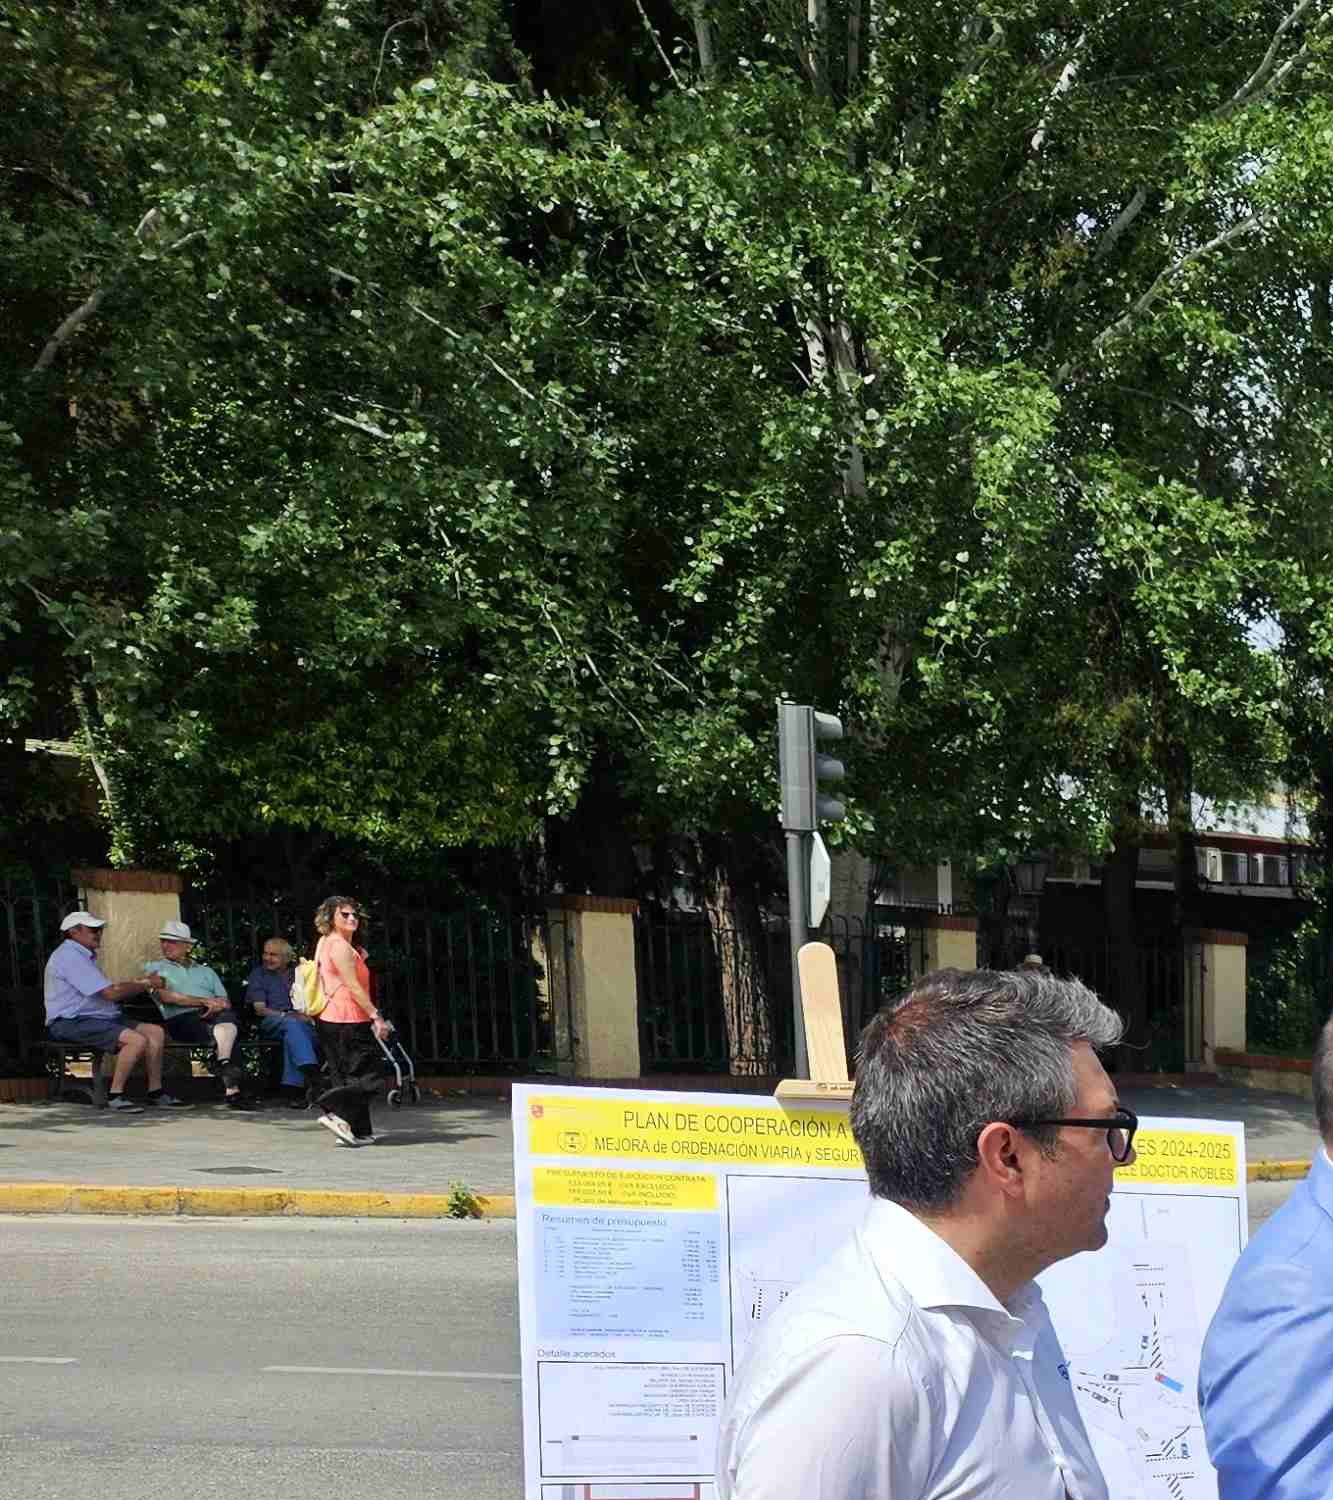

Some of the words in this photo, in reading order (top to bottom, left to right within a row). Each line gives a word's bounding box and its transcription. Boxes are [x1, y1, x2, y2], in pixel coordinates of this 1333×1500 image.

[624, 1110, 669, 1129] PLAN
[675, 1113, 698, 1131] DE
[704, 1114, 831, 1138] COOPERACIÓN
[838, 1122, 847, 1138] A
[594, 1137, 650, 1152] MEJORA
[653, 1140, 668, 1154] de
[671, 1139, 757, 1158] ORDENACIÓN
[758, 1144, 801, 1159] VIARIA
[805, 1151, 811, 1163] y
[815, 1147, 862, 1162] SEGUR
[1136, 1138, 1156, 1156] ES
[1160, 1140, 1231, 1159] 2024-2025
[1140, 1164, 1189, 1179] DOCTOR
[1191, 1166, 1234, 1181] ROBLES
[542, 1214, 590, 1224] Resumen
[592, 1216, 605, 1225] de
